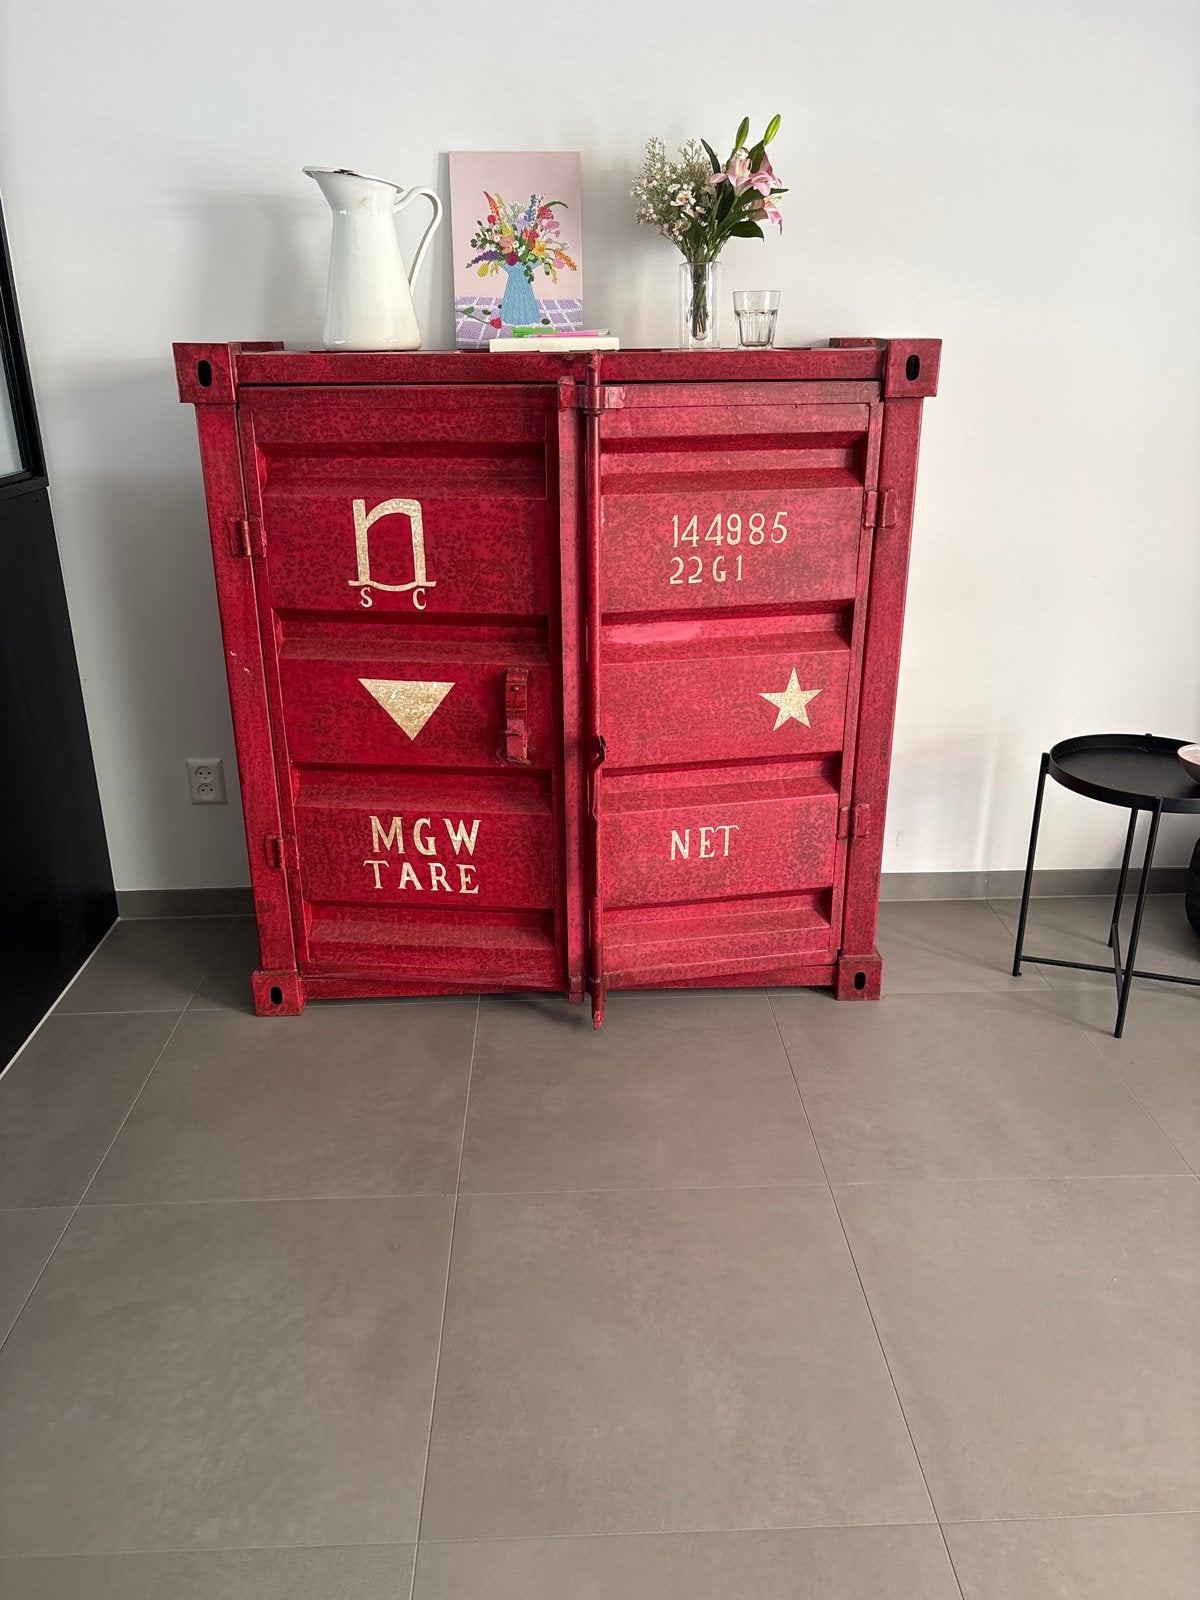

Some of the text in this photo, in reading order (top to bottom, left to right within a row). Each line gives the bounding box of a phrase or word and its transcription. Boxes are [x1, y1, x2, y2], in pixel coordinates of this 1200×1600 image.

[671, 511, 788, 548] 144985
[369, 815, 481, 856] MGW
[670, 824, 740, 860] NET
[363, 860, 480, 894] TARE
